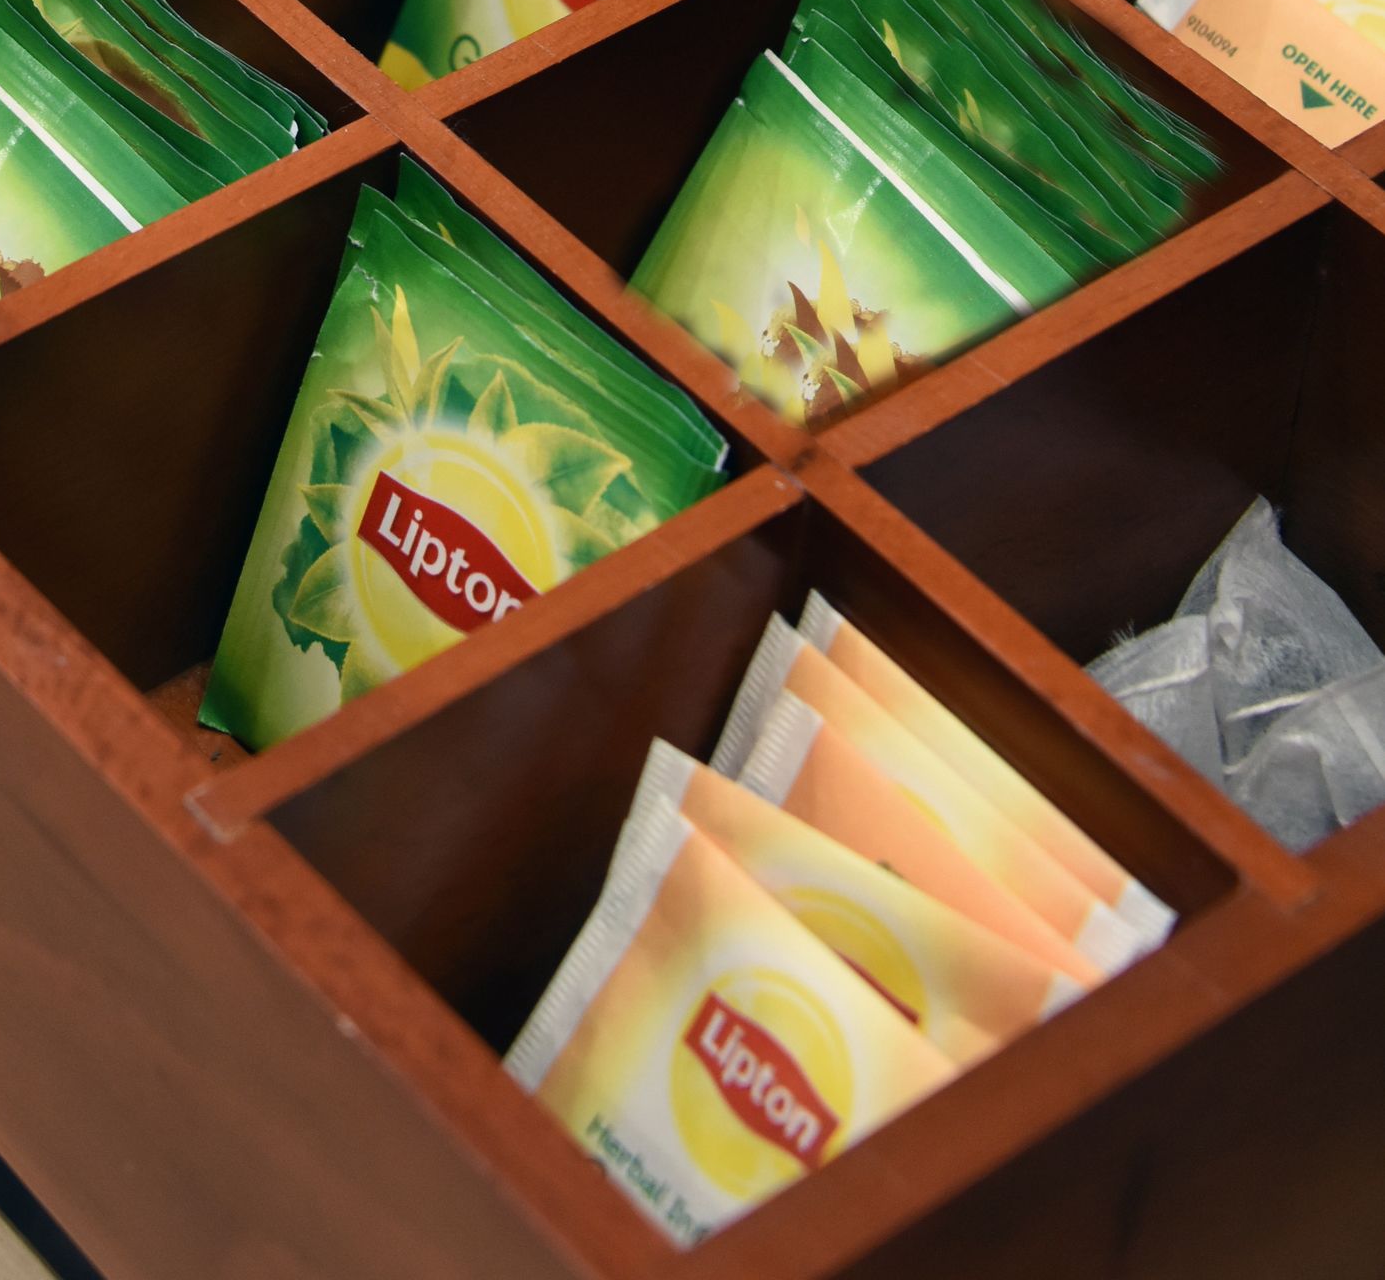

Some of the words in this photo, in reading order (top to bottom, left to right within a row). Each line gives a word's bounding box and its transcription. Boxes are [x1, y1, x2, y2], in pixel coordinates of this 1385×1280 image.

[1186, 13, 1239, 59] 9104094
[1281, 44, 1331, 85] OPEN
[1329, 79, 1379, 121] HERE
[700, 1008, 823, 1153] Lipton
[585, 1113, 670, 1206] Herbal
